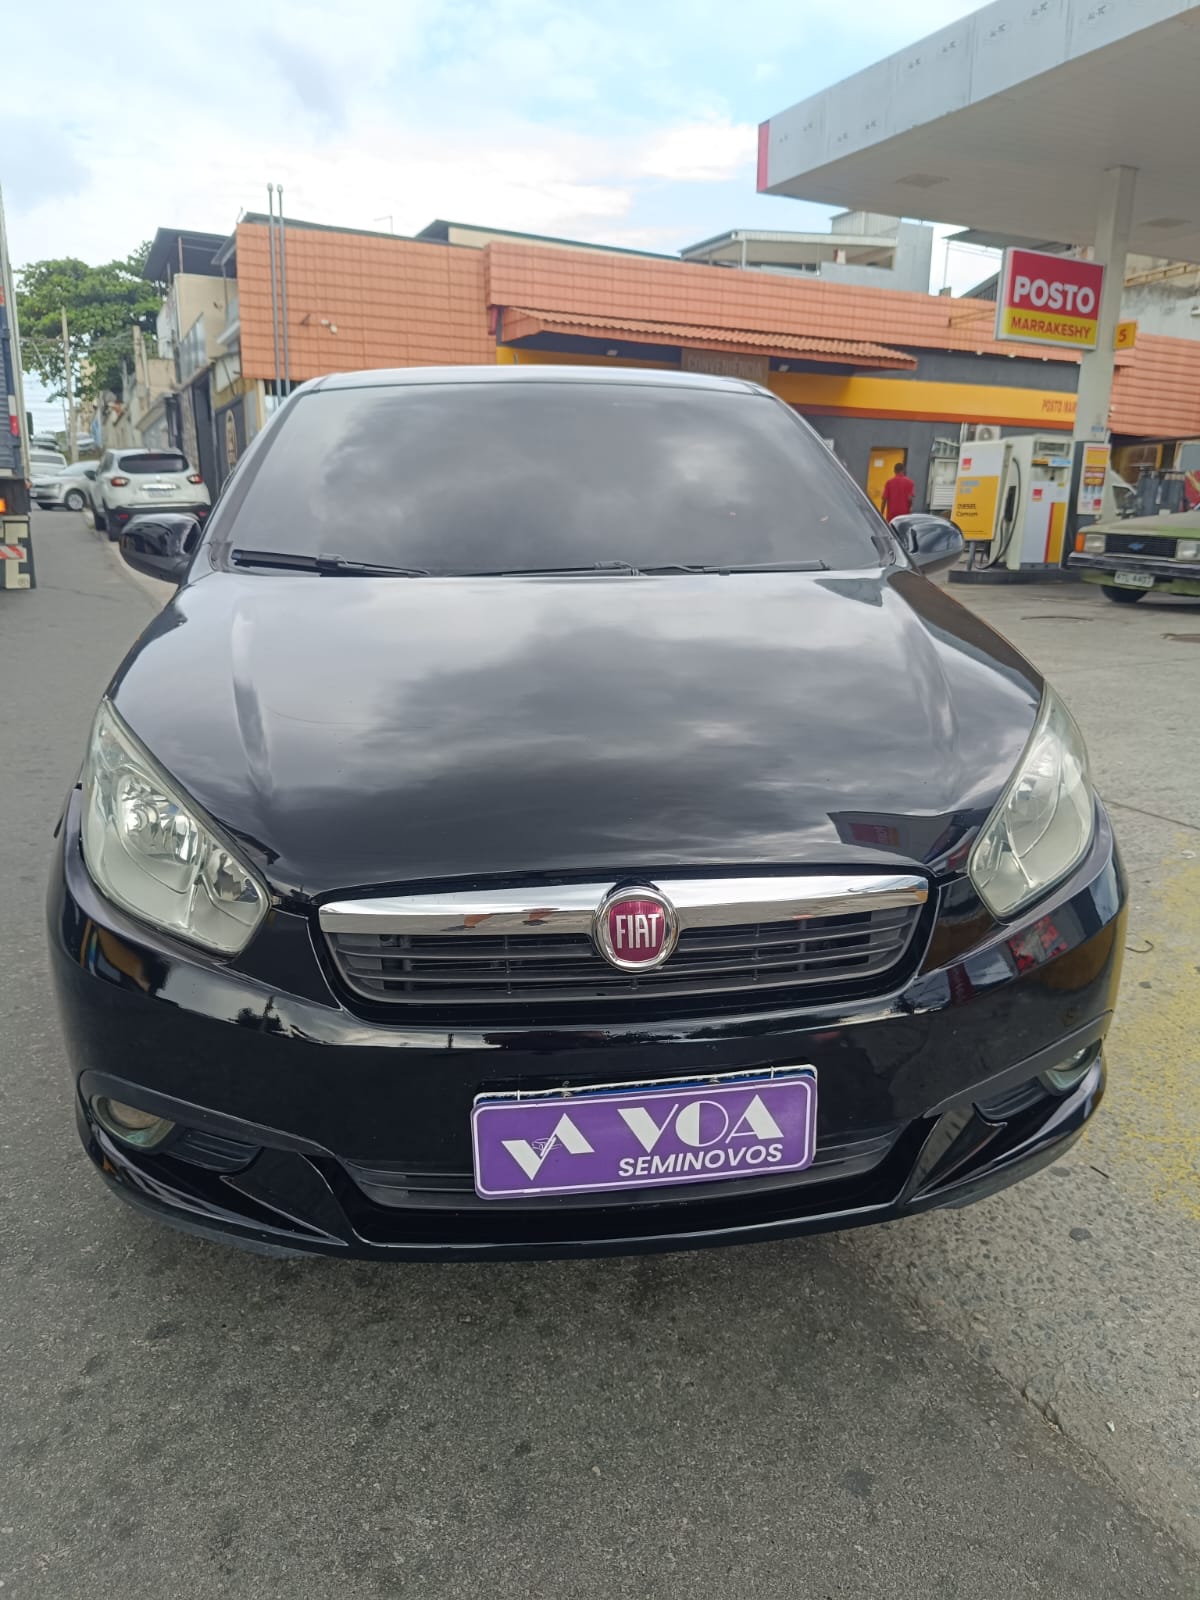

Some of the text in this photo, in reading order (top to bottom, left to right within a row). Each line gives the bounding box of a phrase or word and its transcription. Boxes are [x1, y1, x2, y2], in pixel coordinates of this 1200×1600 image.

[1013, 275, 1095, 314] POSTO
[1011, 316, 1091, 339] MARRAKESHY
[615, 913, 661, 949] FIAT
[617, 1094, 784, 1154] VOA
[618, 1144, 783, 1177] SEMINOVOS
